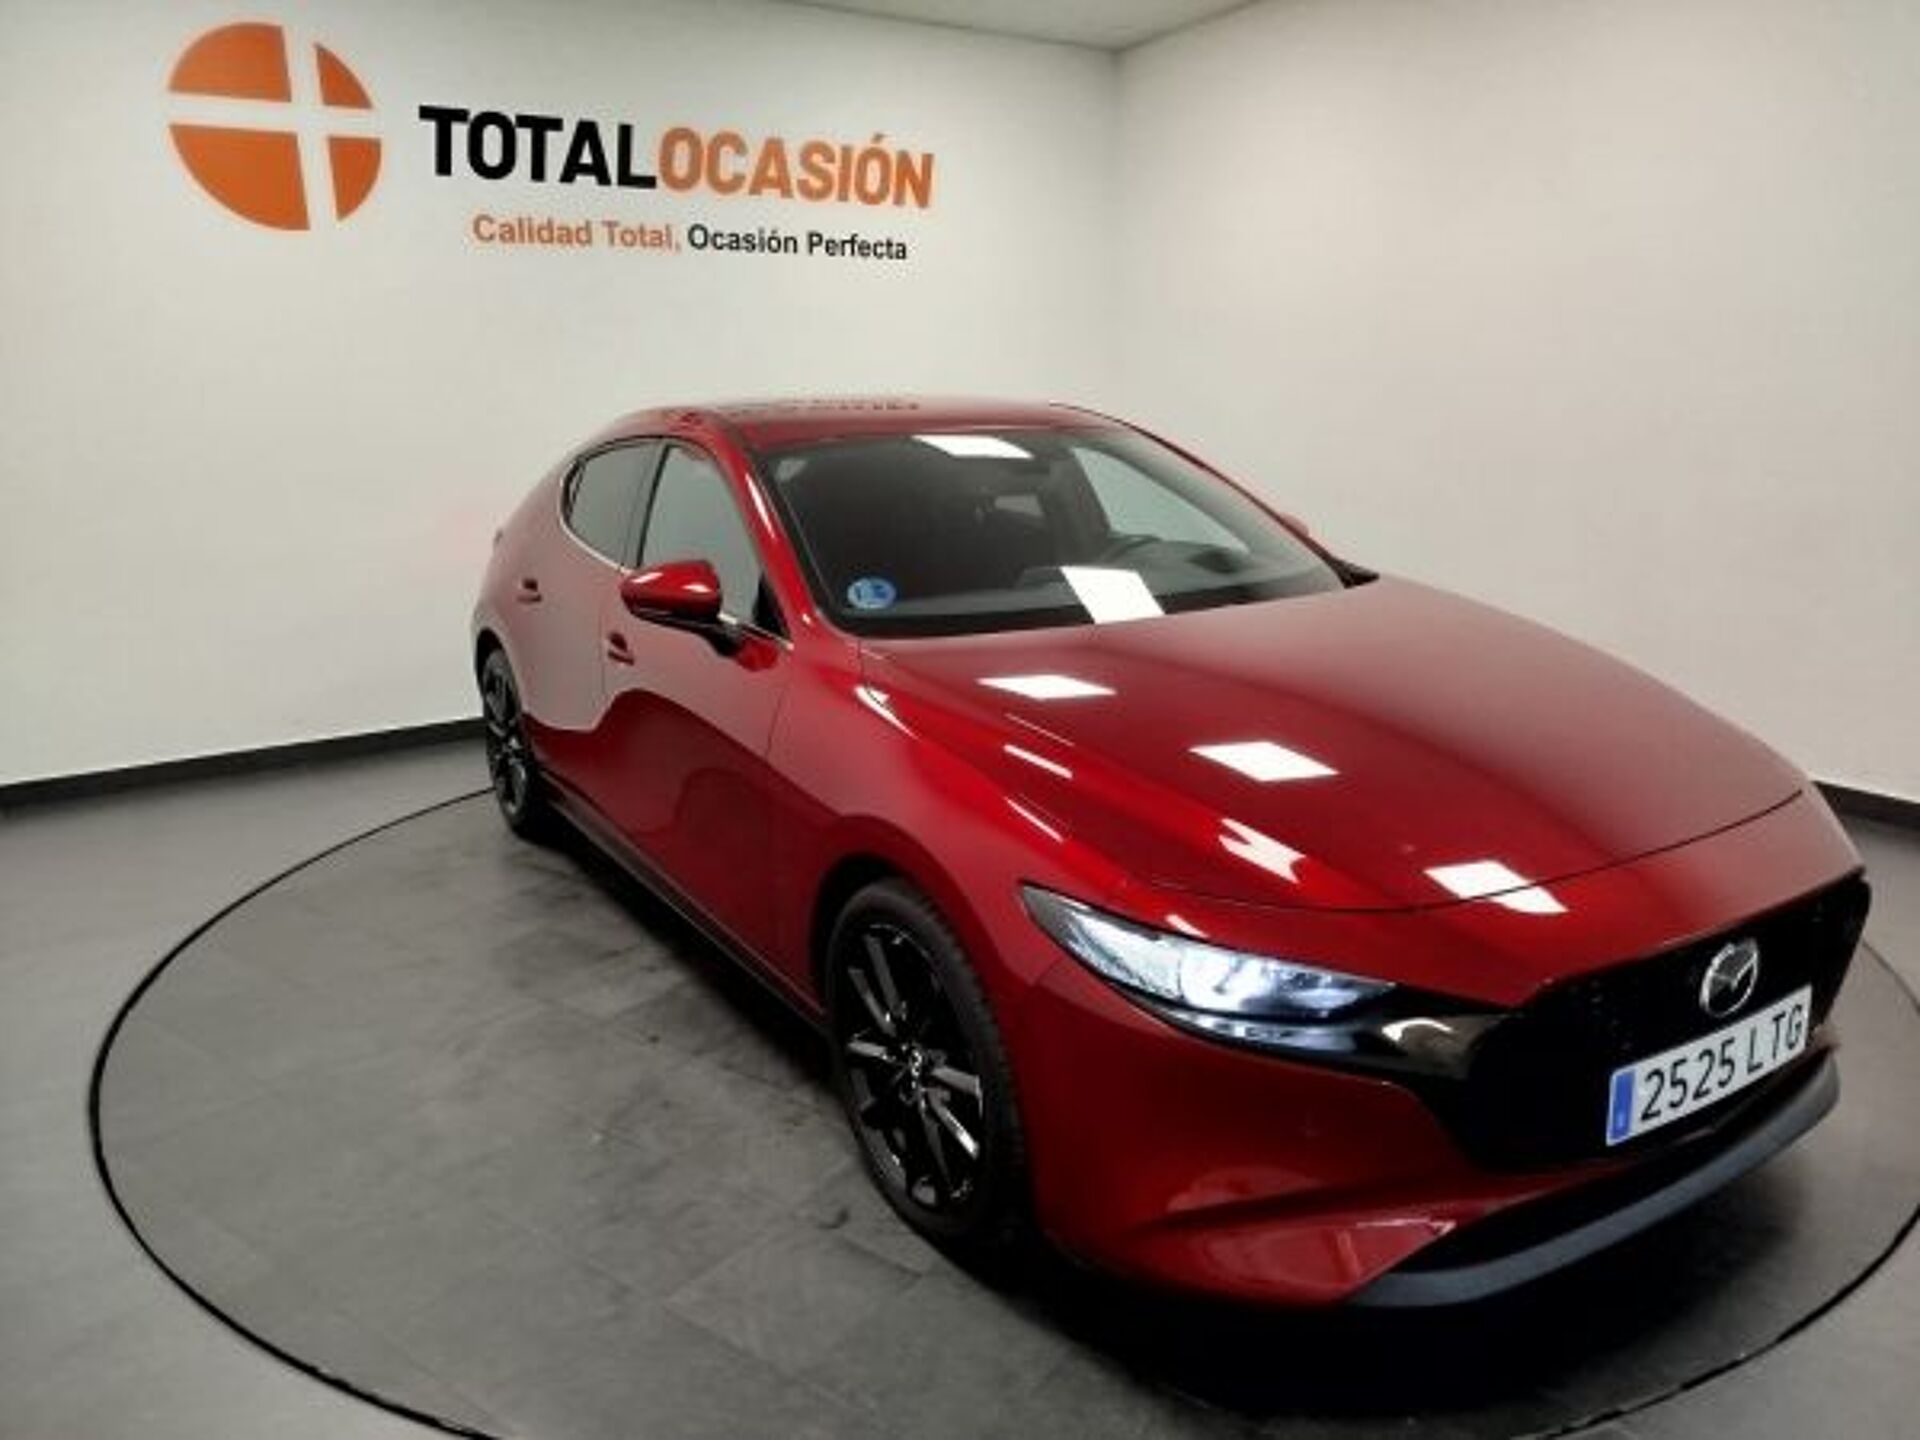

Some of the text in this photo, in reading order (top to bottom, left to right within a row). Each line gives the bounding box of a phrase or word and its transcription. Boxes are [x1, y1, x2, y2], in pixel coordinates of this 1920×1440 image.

[473, 214, 593, 247] Calidad
[688, 224, 798, 254] Ocasión
[808, 232, 908, 260] Perfecta
[1641, 1003, 1803, 1121] 2525 LTG
